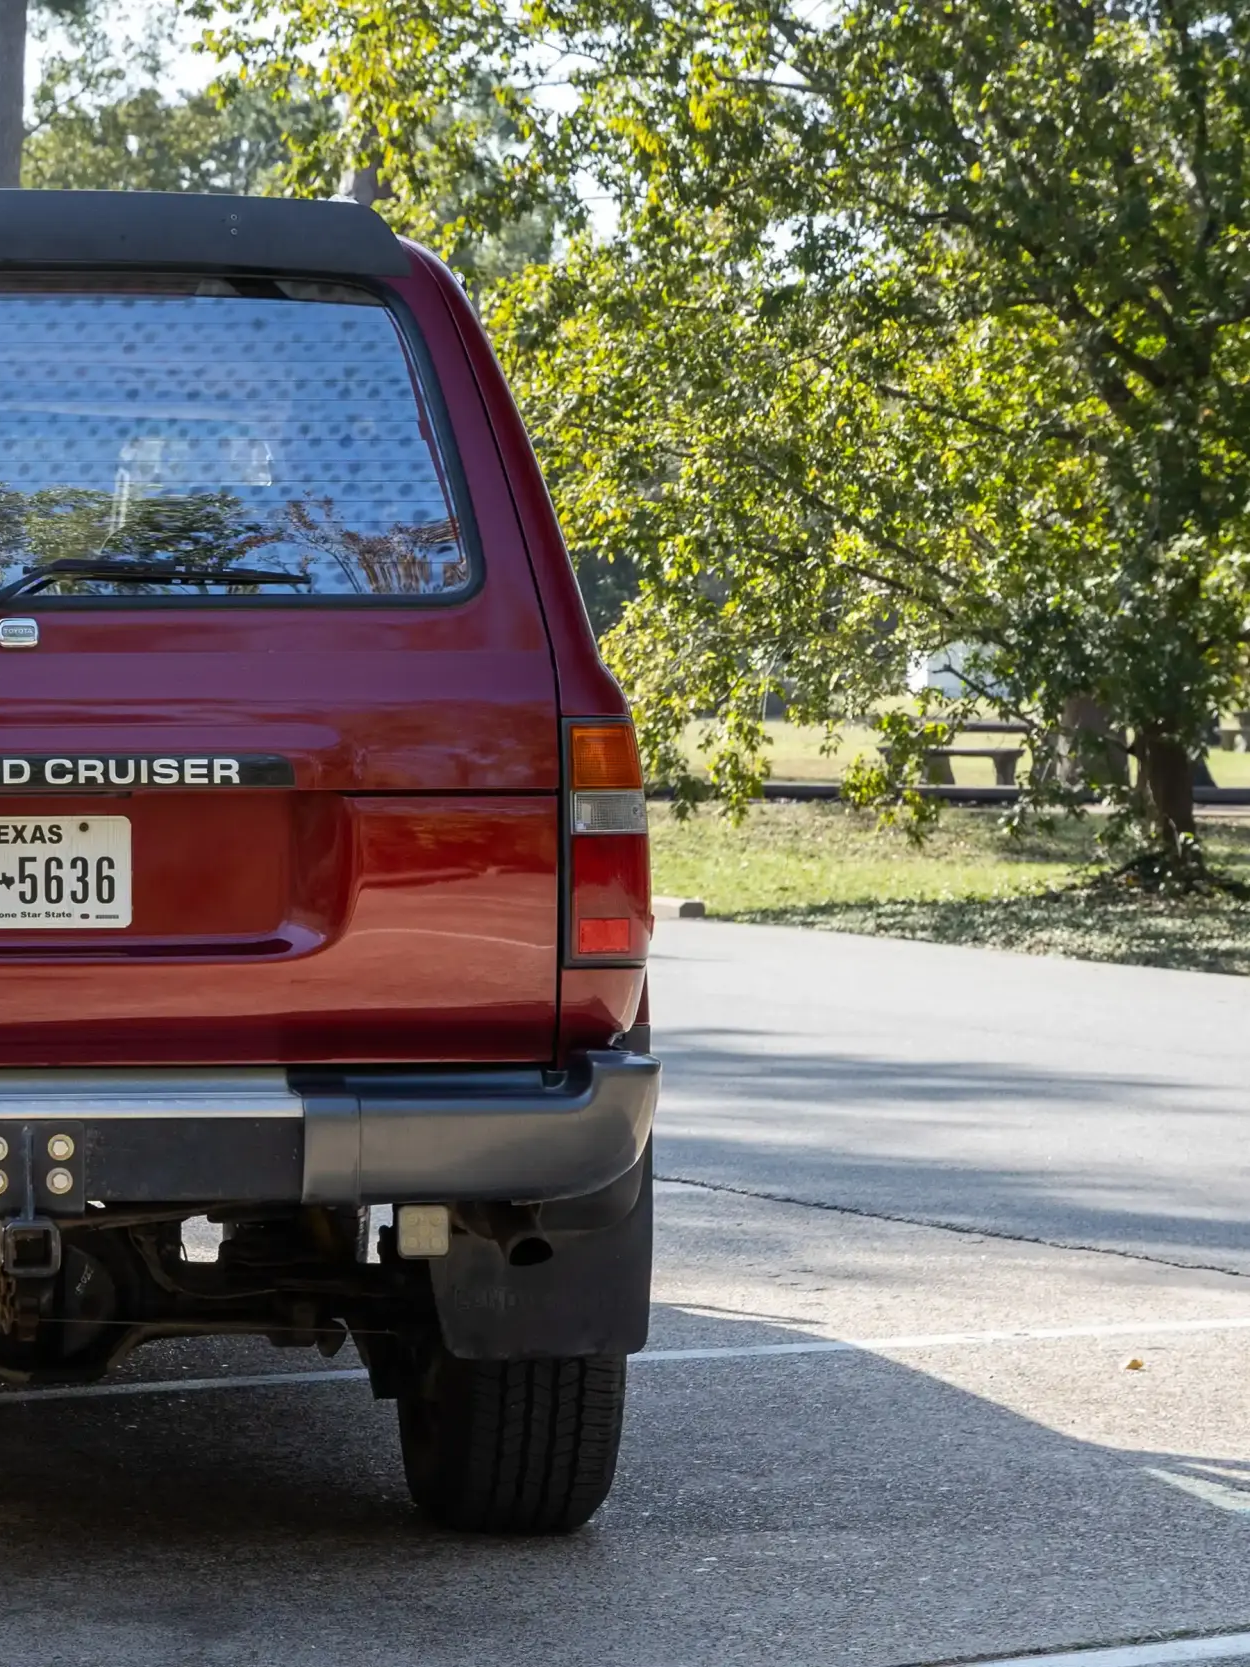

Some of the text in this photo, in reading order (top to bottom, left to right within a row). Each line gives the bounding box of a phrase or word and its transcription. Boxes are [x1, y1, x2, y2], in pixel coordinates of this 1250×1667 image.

[3, 627, 34, 635] TOYOTA
[43, 758, 241, 785] CRUISER
[20, 911, 43, 919] Star
[45, 911, 73, 919] State
